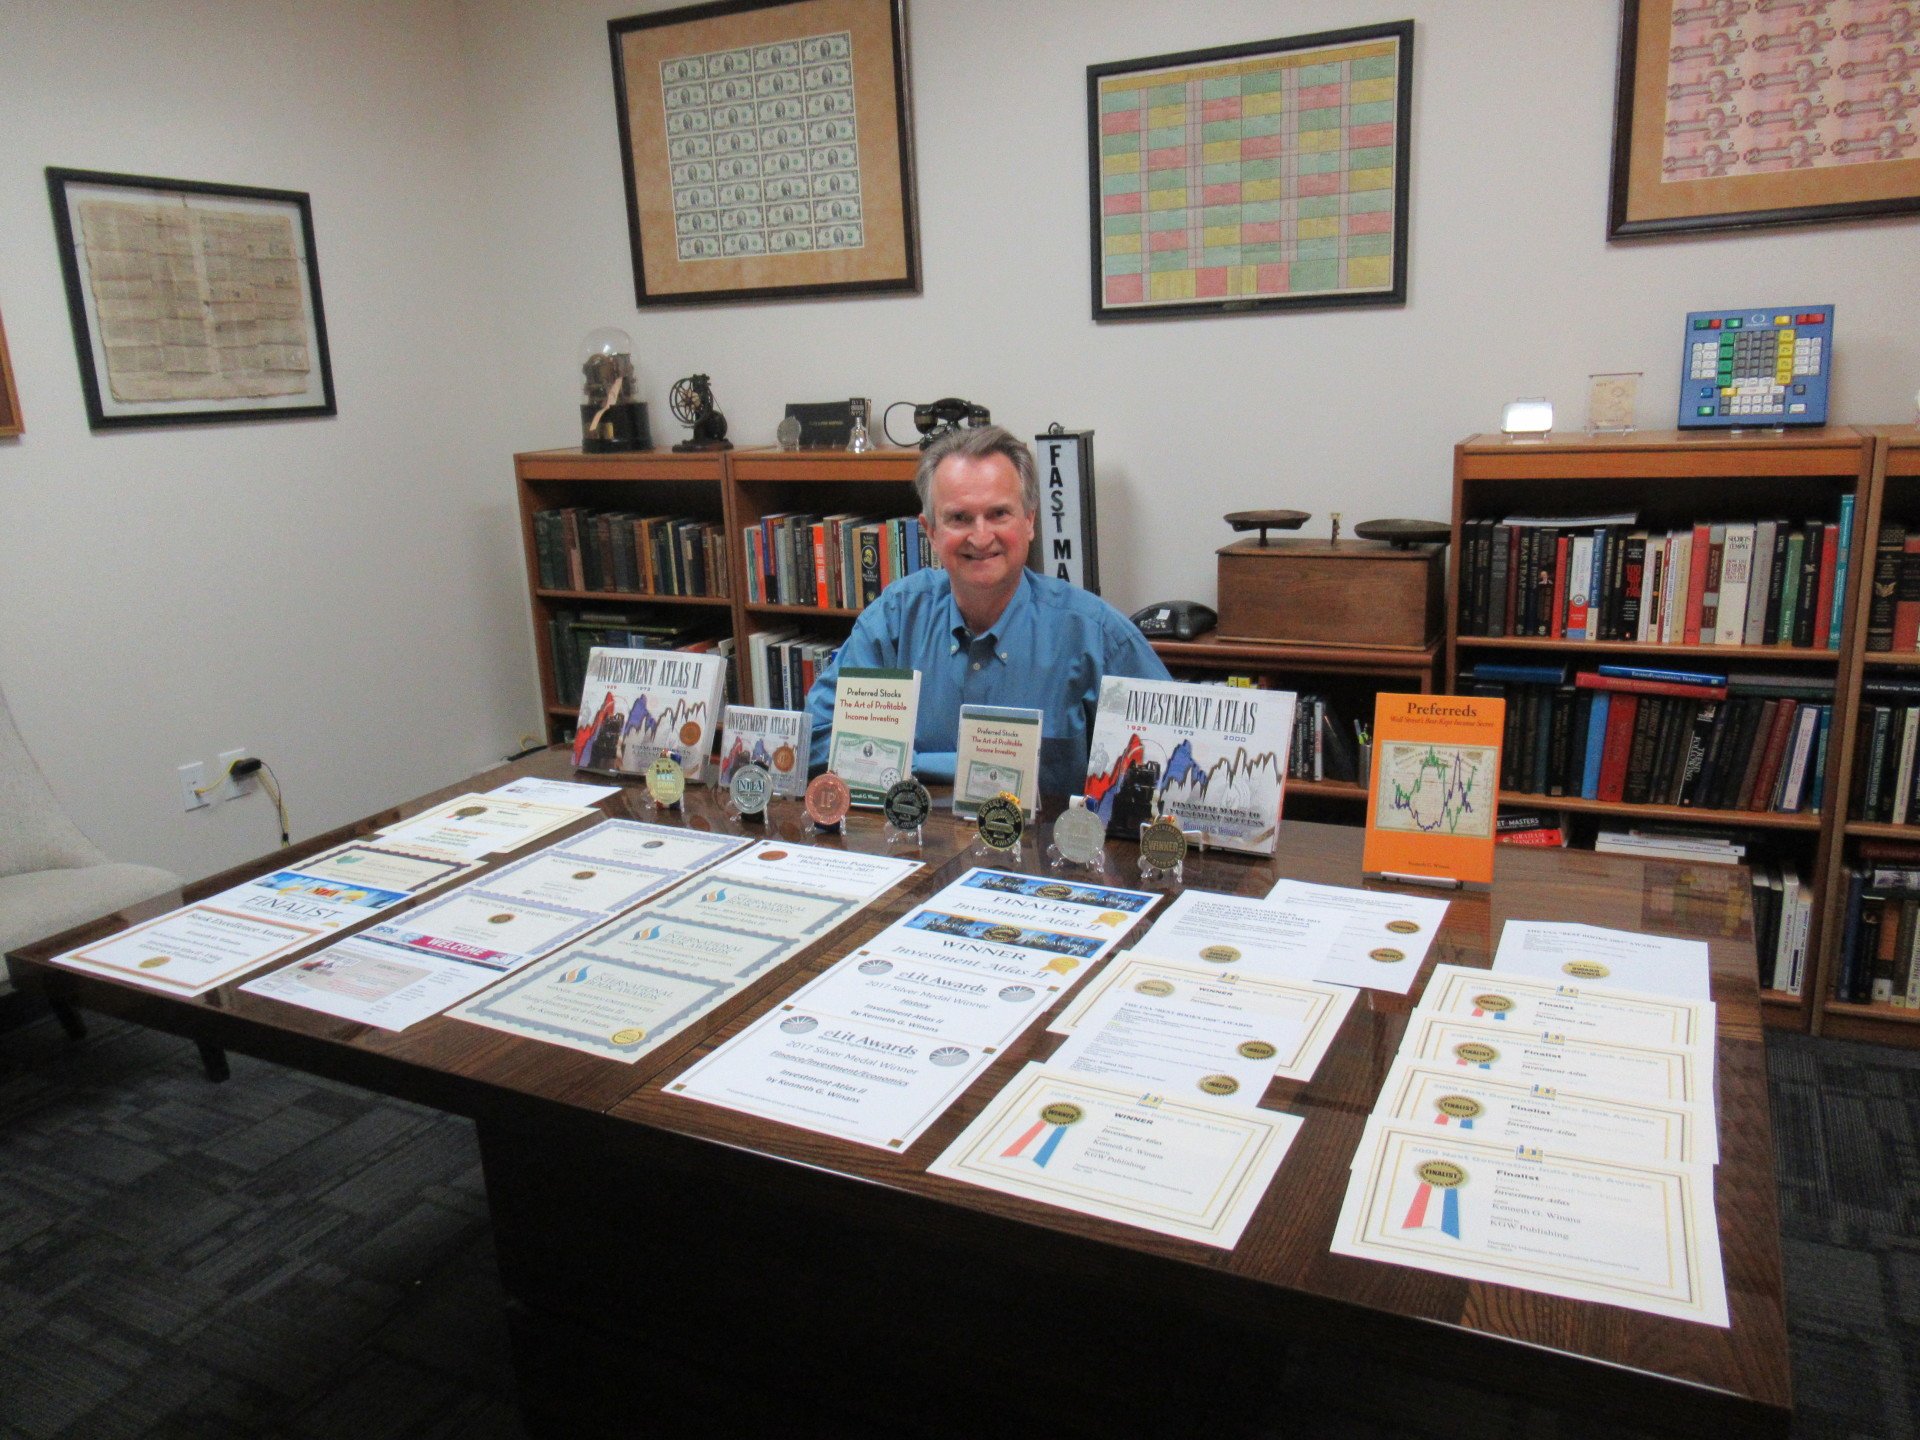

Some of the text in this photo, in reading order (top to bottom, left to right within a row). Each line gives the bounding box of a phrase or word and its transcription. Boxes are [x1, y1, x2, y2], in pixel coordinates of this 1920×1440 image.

[1049, 445, 1065, 533] FAST
[1518, 564, 1528, 588] TRAP
[597, 656, 703, 689] INVESTMENT ATLAS II
[847, 687, 901, 698] Preferred Stocks
[840, 699, 907, 711] The Art of Profitable
[1125, 690, 1258, 736] INVESTMENT ATLAS
[1407, 702, 1478, 717] Preferreds
[728, 712, 768, 733] INVESTMENT
[769, 716, 789, 735] ATLAS
[845, 712, 899, 724] Income Investing
[977, 727, 1018, 738] Preferred Stocks
[1126, 724, 1147, 732] 1929
[972, 736, 982, 744] The
[1224, 735, 1246, 743] 2000
[1695, 747, 1705, 773] TREND
[1512, 832, 1545, 840] GRAHAM
[246, 896, 345, 918] FINALIST
[992, 896, 1086, 916] FINALIST
[952, 902, 1042, 921] Investment
[1044, 916, 1078, 928] Atlas
[426, 936, 486, 956] WELCOME
[942, 940, 1027, 961] WINNER
[892, 946, 980, 968] Investment
[982, 962, 1028, 977] Atlas
[898, 970, 988, 994] eLit Awards
[865, 980, 991, 1010] 2017 Silver Medal Winner
[1199, 986, 1234, 997] WINNER
[864, 1004, 912, 1018] Investment
[915, 1013, 937, 1022] Atlas
[1538, 1002, 1574, 1010] Finalist
[850, 1010, 940, 1033] by Kenneth G. Winans
[1535, 1014, 1576, 1025] Investment
[824, 1030, 919, 1056] eLit Awards
[786, 1040, 920, 1076] 2017 Silver Medal Winner
[1524, 1050, 1562, 1060] Finalist
[1522, 1064, 1566, 1075] Investment
[780, 1068, 868, 1094] Investment Atlas II
[766, 1076, 861, 1104] by Kenneth G. Winans
[1048, 1109, 1074, 1119] WINNER
[1443, 1102, 1474, 1111] FINALIST
[1510, 1104, 1552, 1116] Finalist
[1114, 1112, 1154, 1126] WINNER
[1506, 1120, 1554, 1133] Investment
[1102, 1128, 1143, 1142] Investment
[1093, 1138, 1124, 1152] Kenneth
[1137, 1148, 1164, 1160] Winans
[1107, 1154, 1146, 1172] Publishing
[1424, 1168, 1458, 1179] FINALIST
[1496, 1170, 1541, 1181] Finalist
[1606, 1177, 1652, 1190] Awards
[1494, 1189, 1571, 1206] Investment Atlas
[1492, 1202, 1530, 1216] Kenneth
[1546, 1210, 1582, 1224] Winans
[1489, 1219, 1570, 1240] KGW Publishing
